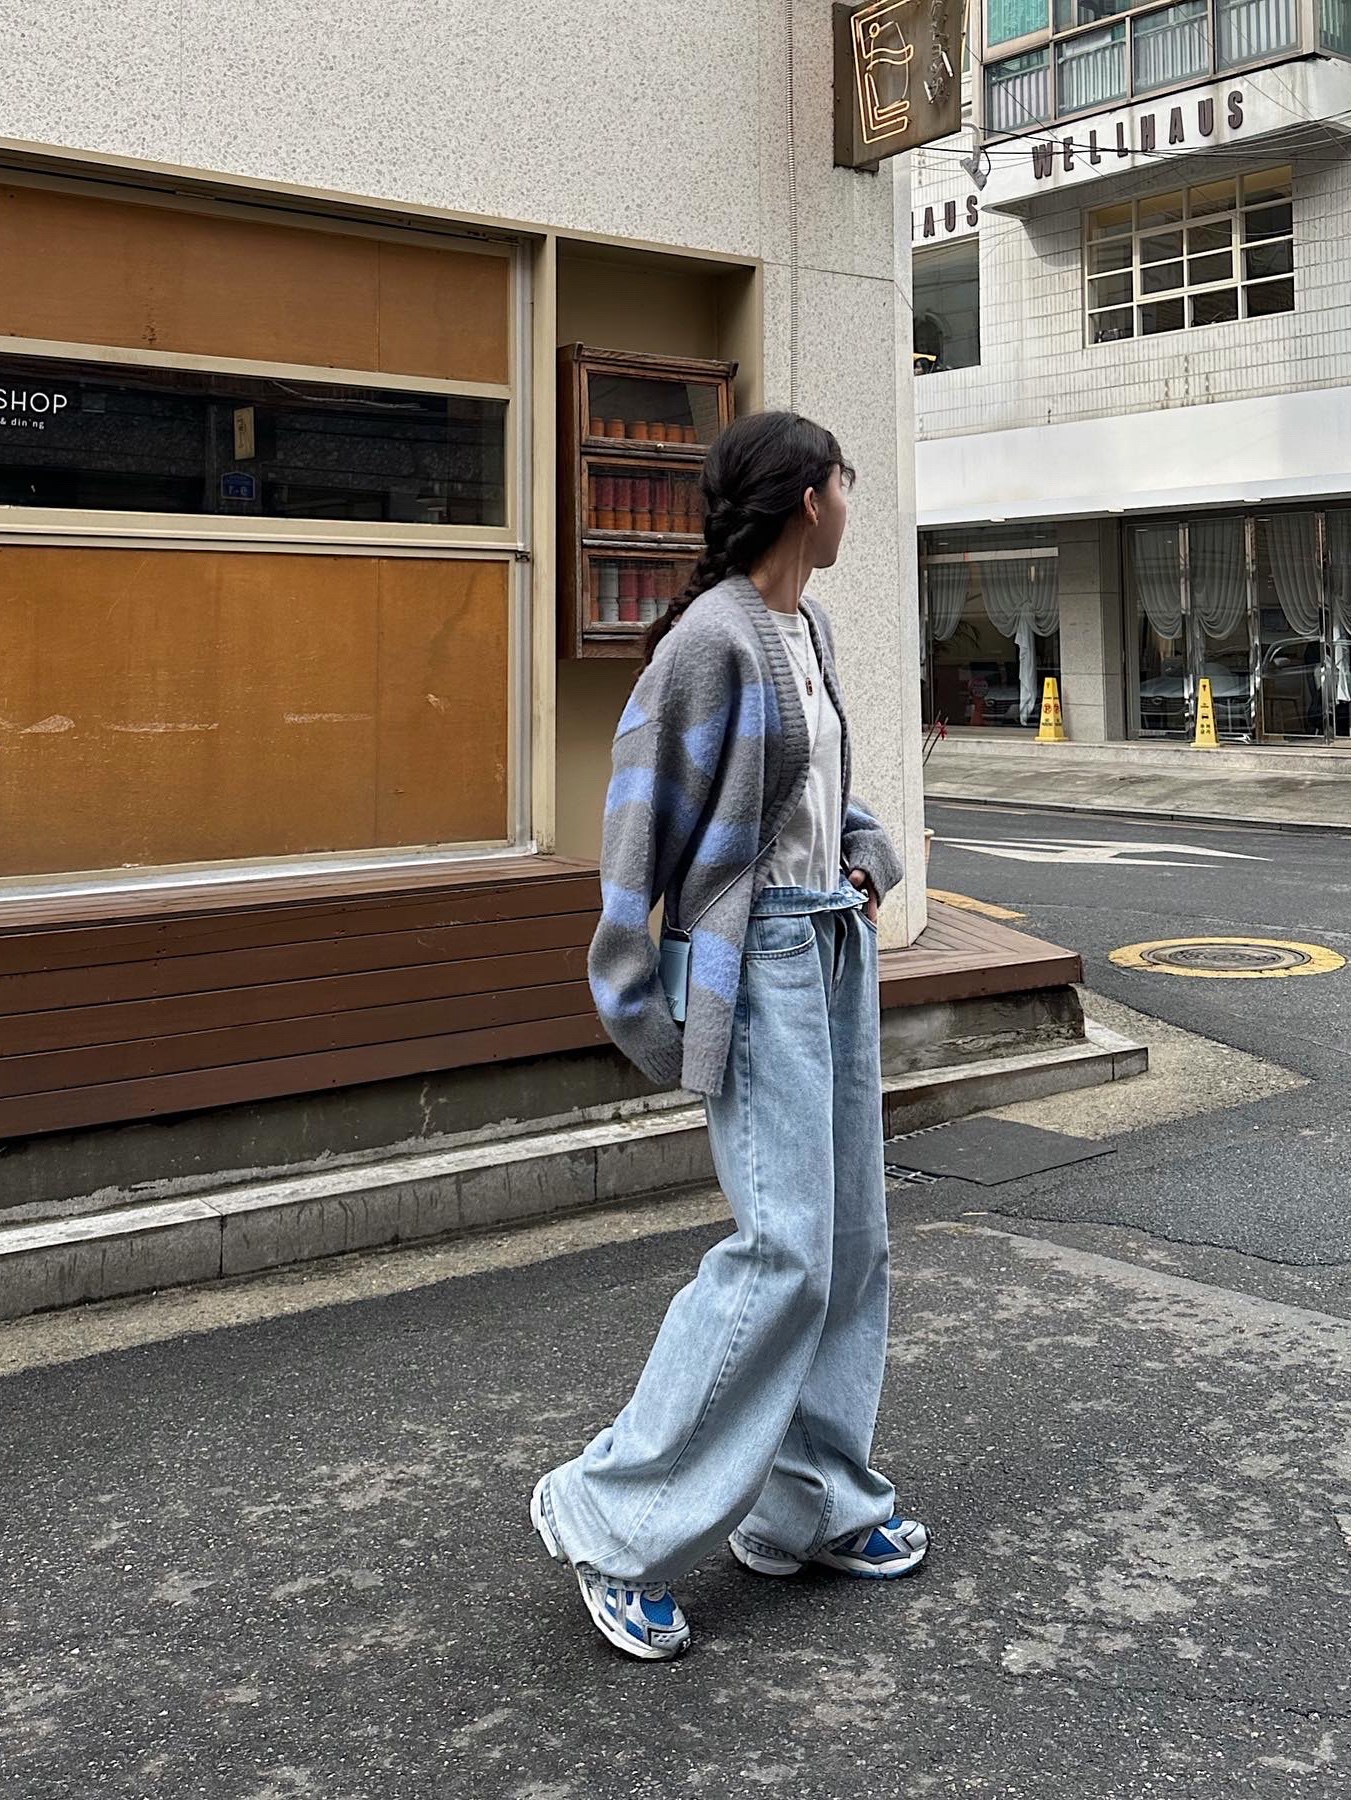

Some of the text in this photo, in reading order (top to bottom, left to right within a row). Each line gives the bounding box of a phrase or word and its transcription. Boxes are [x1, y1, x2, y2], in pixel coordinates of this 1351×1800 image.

[1031, 90, 1244, 179] WELLHAUS
[911, 195, 978, 240] AUS
[11, 418, 45, 430] dinng
